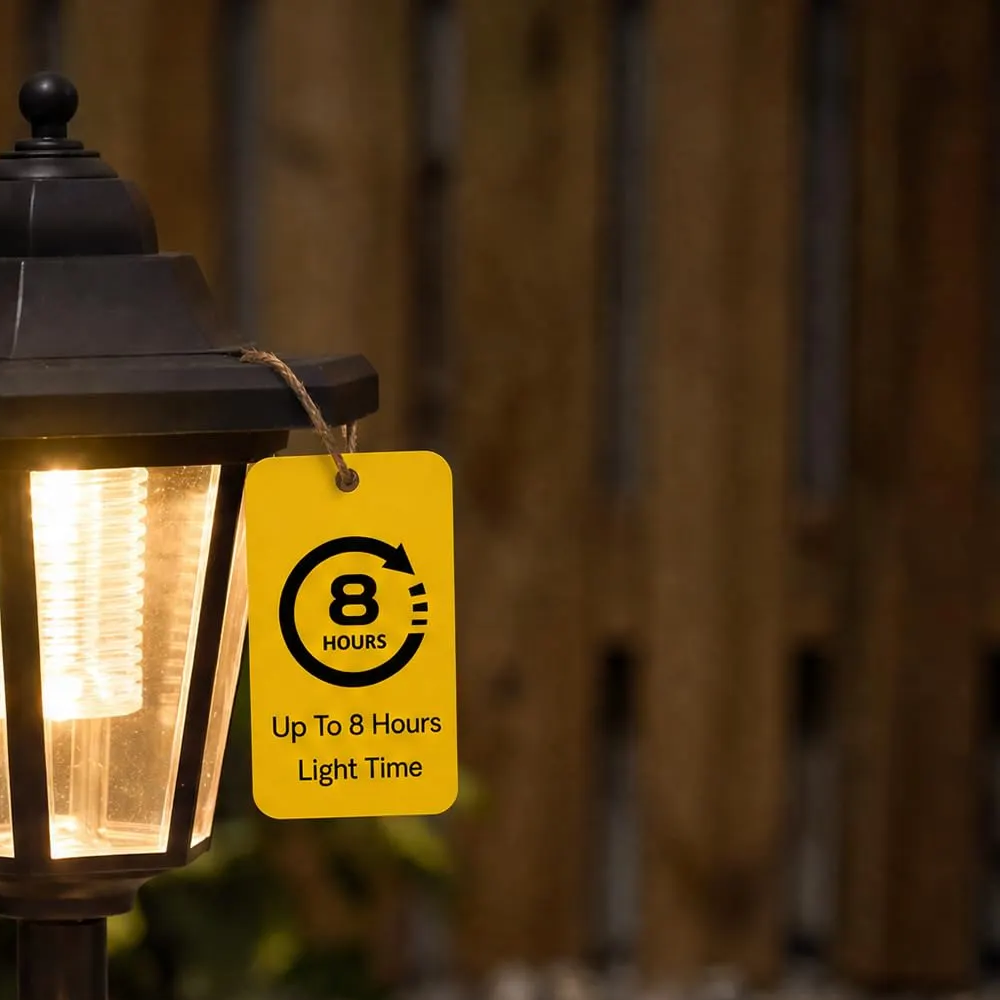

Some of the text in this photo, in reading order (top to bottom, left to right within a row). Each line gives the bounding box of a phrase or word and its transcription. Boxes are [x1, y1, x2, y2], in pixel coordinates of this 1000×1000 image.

[329, 573, 379, 626] 8
[323, 634, 387, 651] HOURS
[272, 712, 442, 744] Up To 8 Hours
[298, 756, 423, 787] Light Time
